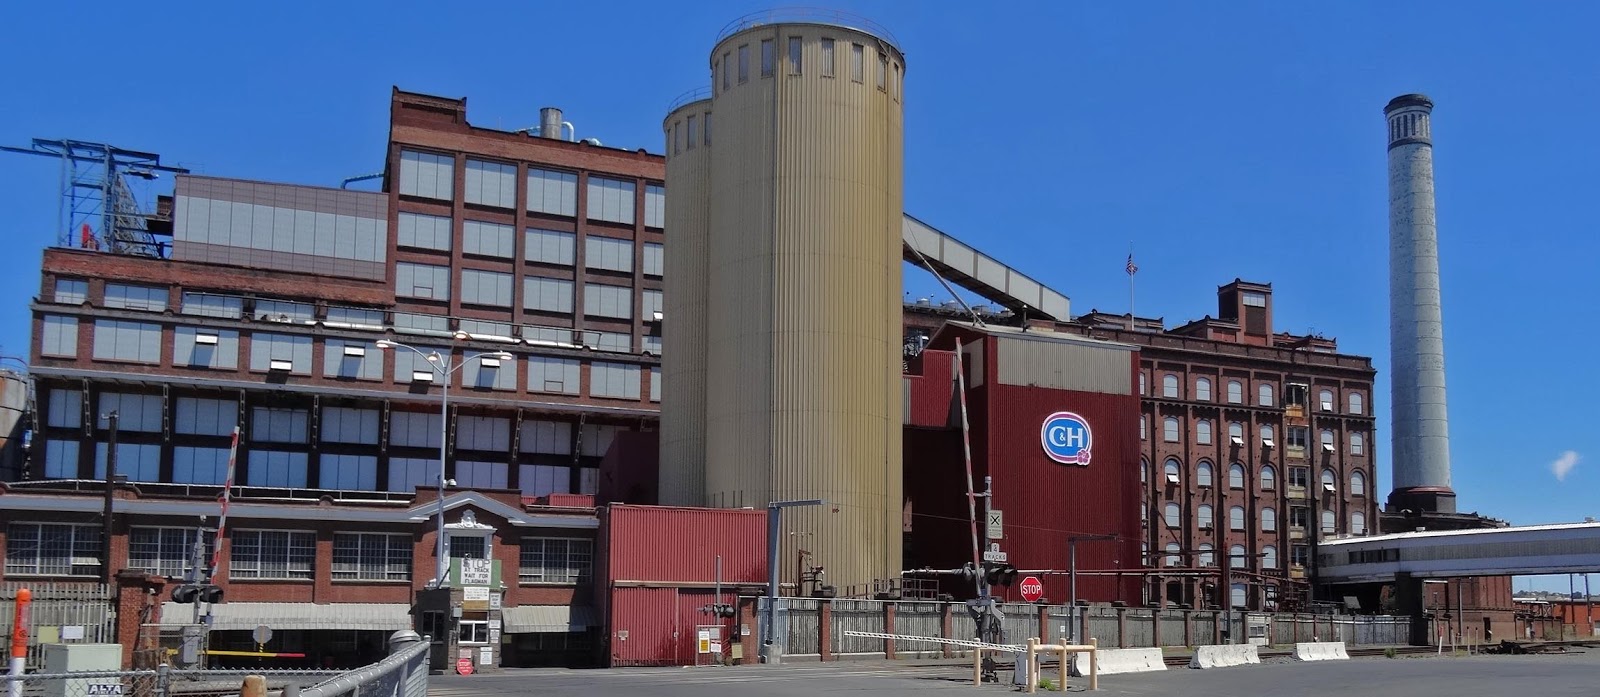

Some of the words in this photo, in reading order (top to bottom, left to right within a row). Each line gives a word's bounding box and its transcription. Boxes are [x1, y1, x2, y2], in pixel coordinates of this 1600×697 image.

[1049, 426, 1083, 447] C&H
[463, 558, 490, 568] STOP
[1022, 584, 1041, 595] STOP
[89, 685, 121, 694] ALTA
